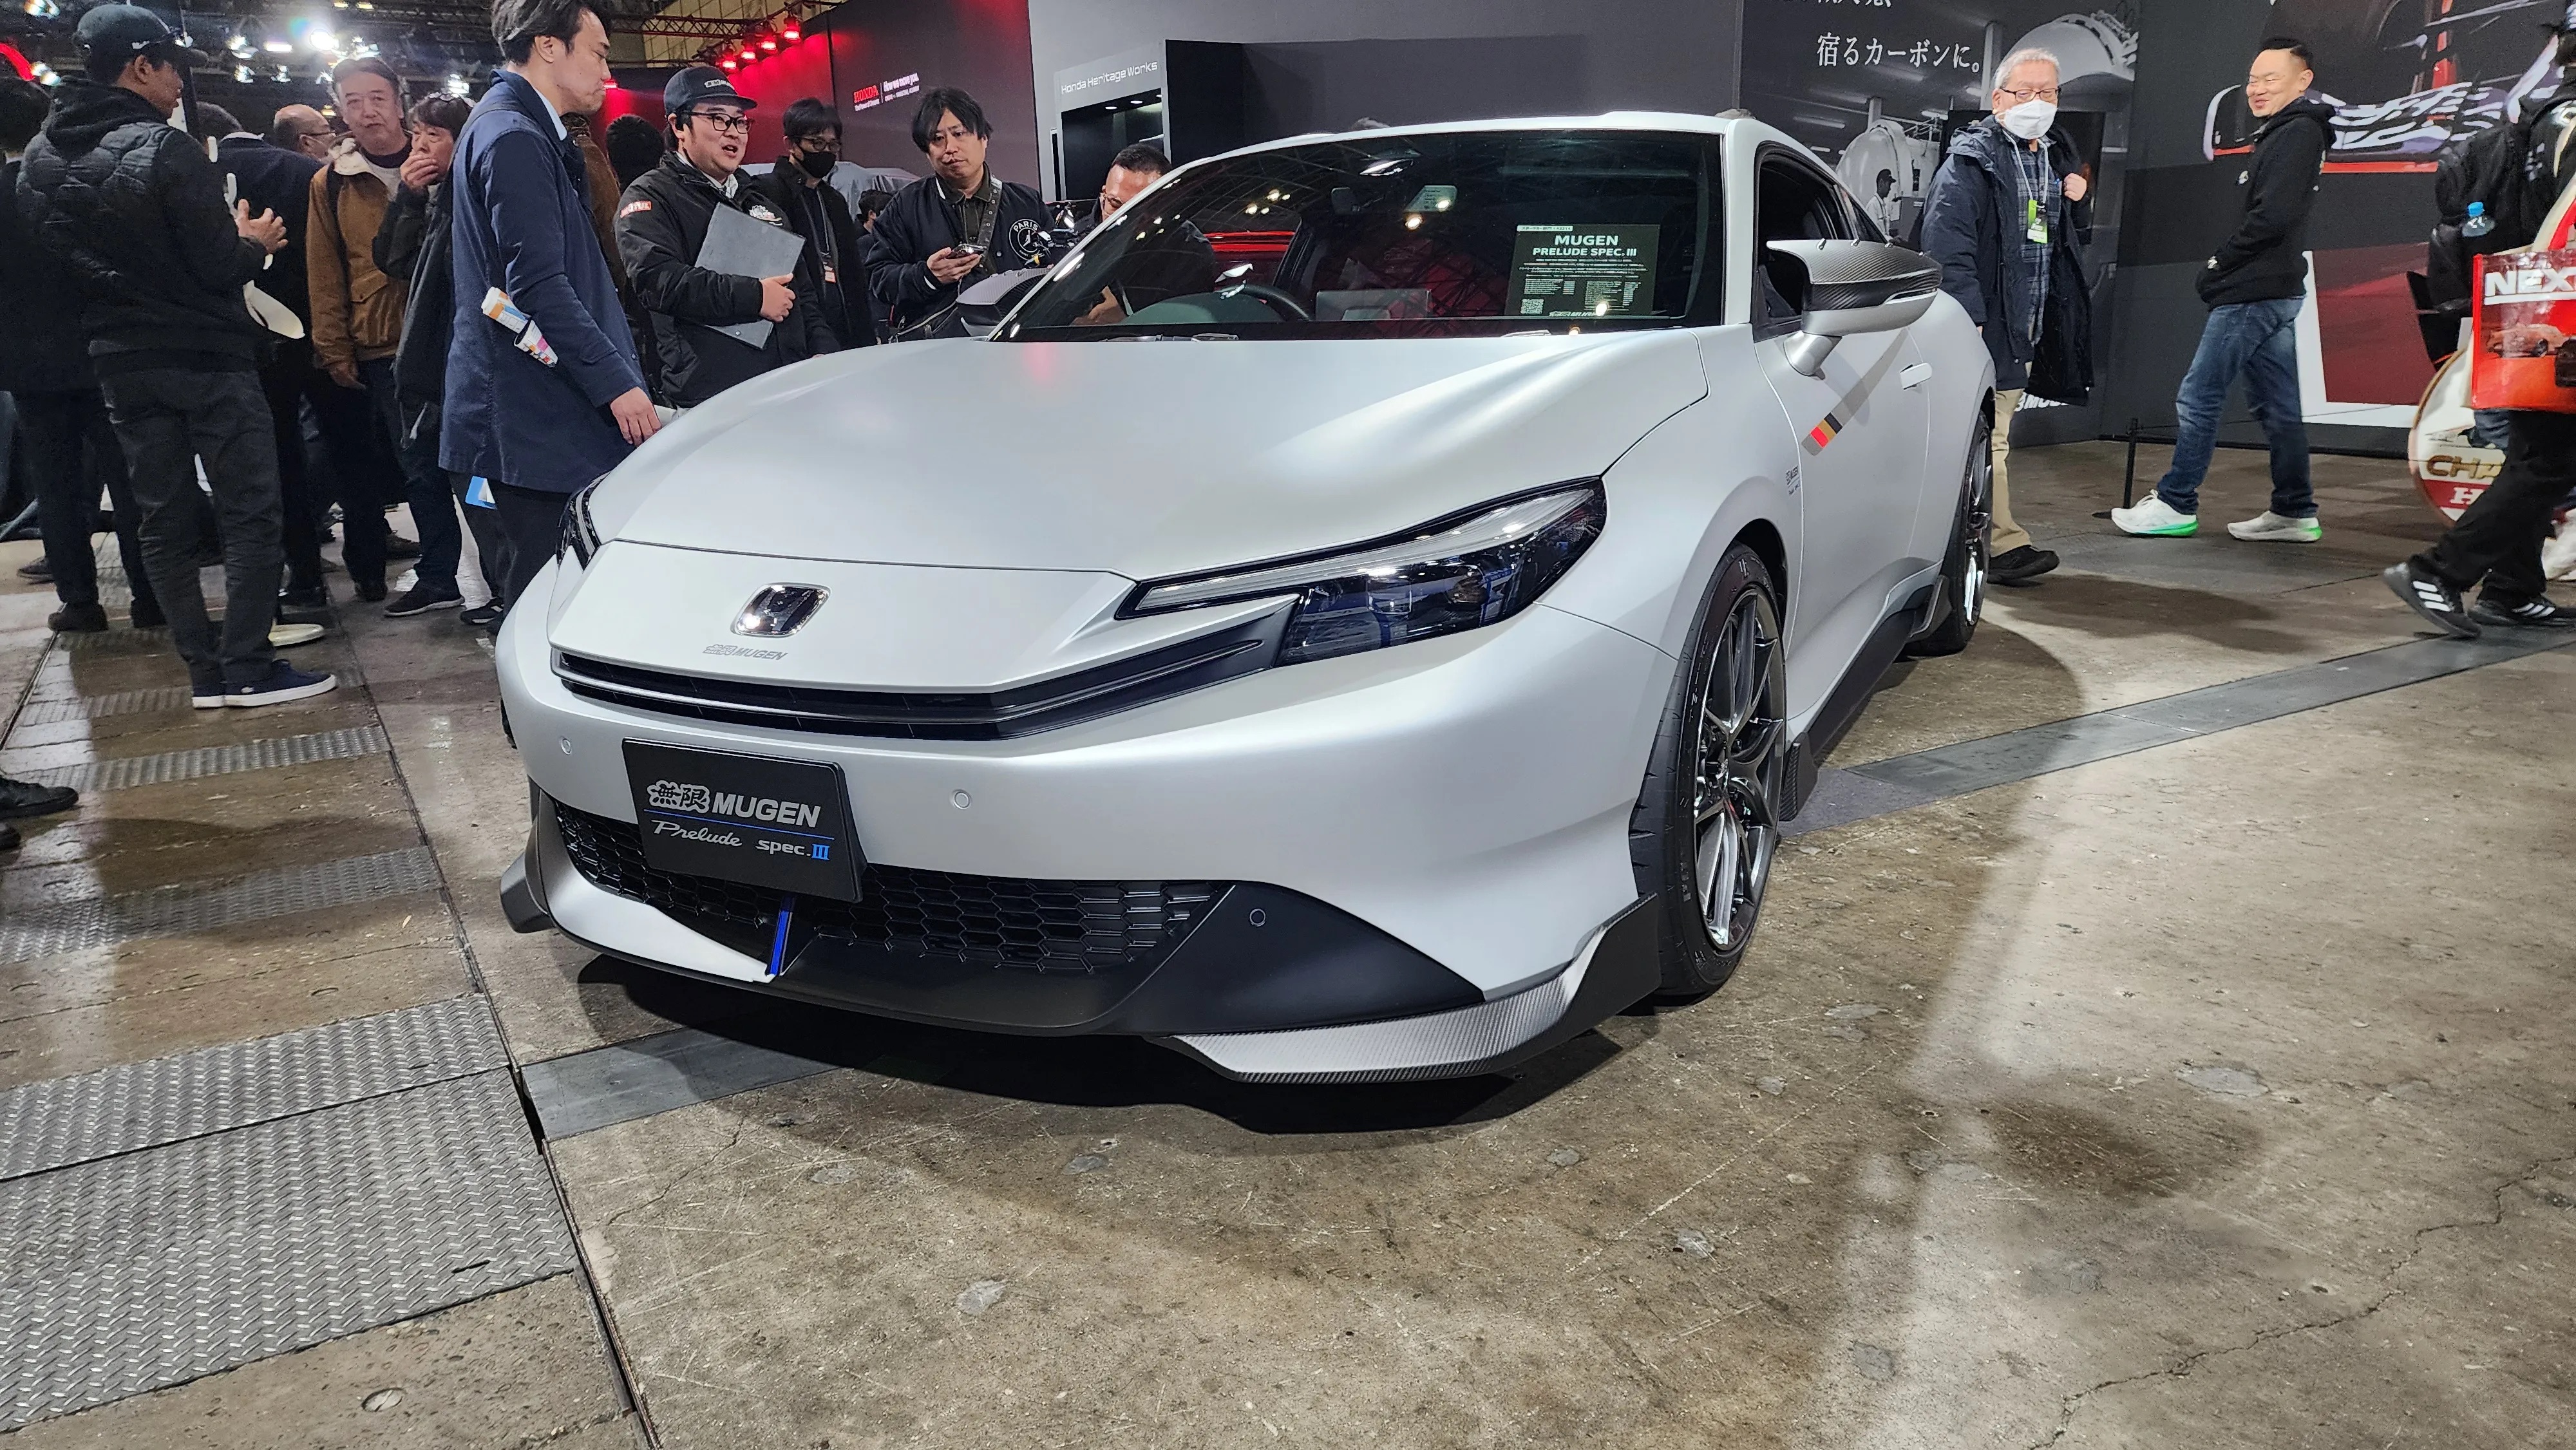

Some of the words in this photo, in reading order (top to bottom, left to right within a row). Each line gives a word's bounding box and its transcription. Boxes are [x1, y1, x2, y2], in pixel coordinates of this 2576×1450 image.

[1817, 32, 1980, 72] 宿るカーボンに。
[1061, 80, 1086, 95] Honda
[1088, 70, 1126, 87] Heritage
[1127, 61, 1158, 77] Works
[853, 85, 879, 103] HONDA
[1013, 220, 1038, 232] PARIS
[1532, 247, 1588, 256] PRELUDE
[1555, 235, 1618, 246] MUGEN
[2485, 266, 2576, 297] NEX
[2427, 455, 2503, 479] CHA
[732, 648, 789, 661] MUGEN
[647, 780, 710, 813] 無限
[712, 792, 821, 828] MUGEN
[651, 820, 743, 847] Prelude
